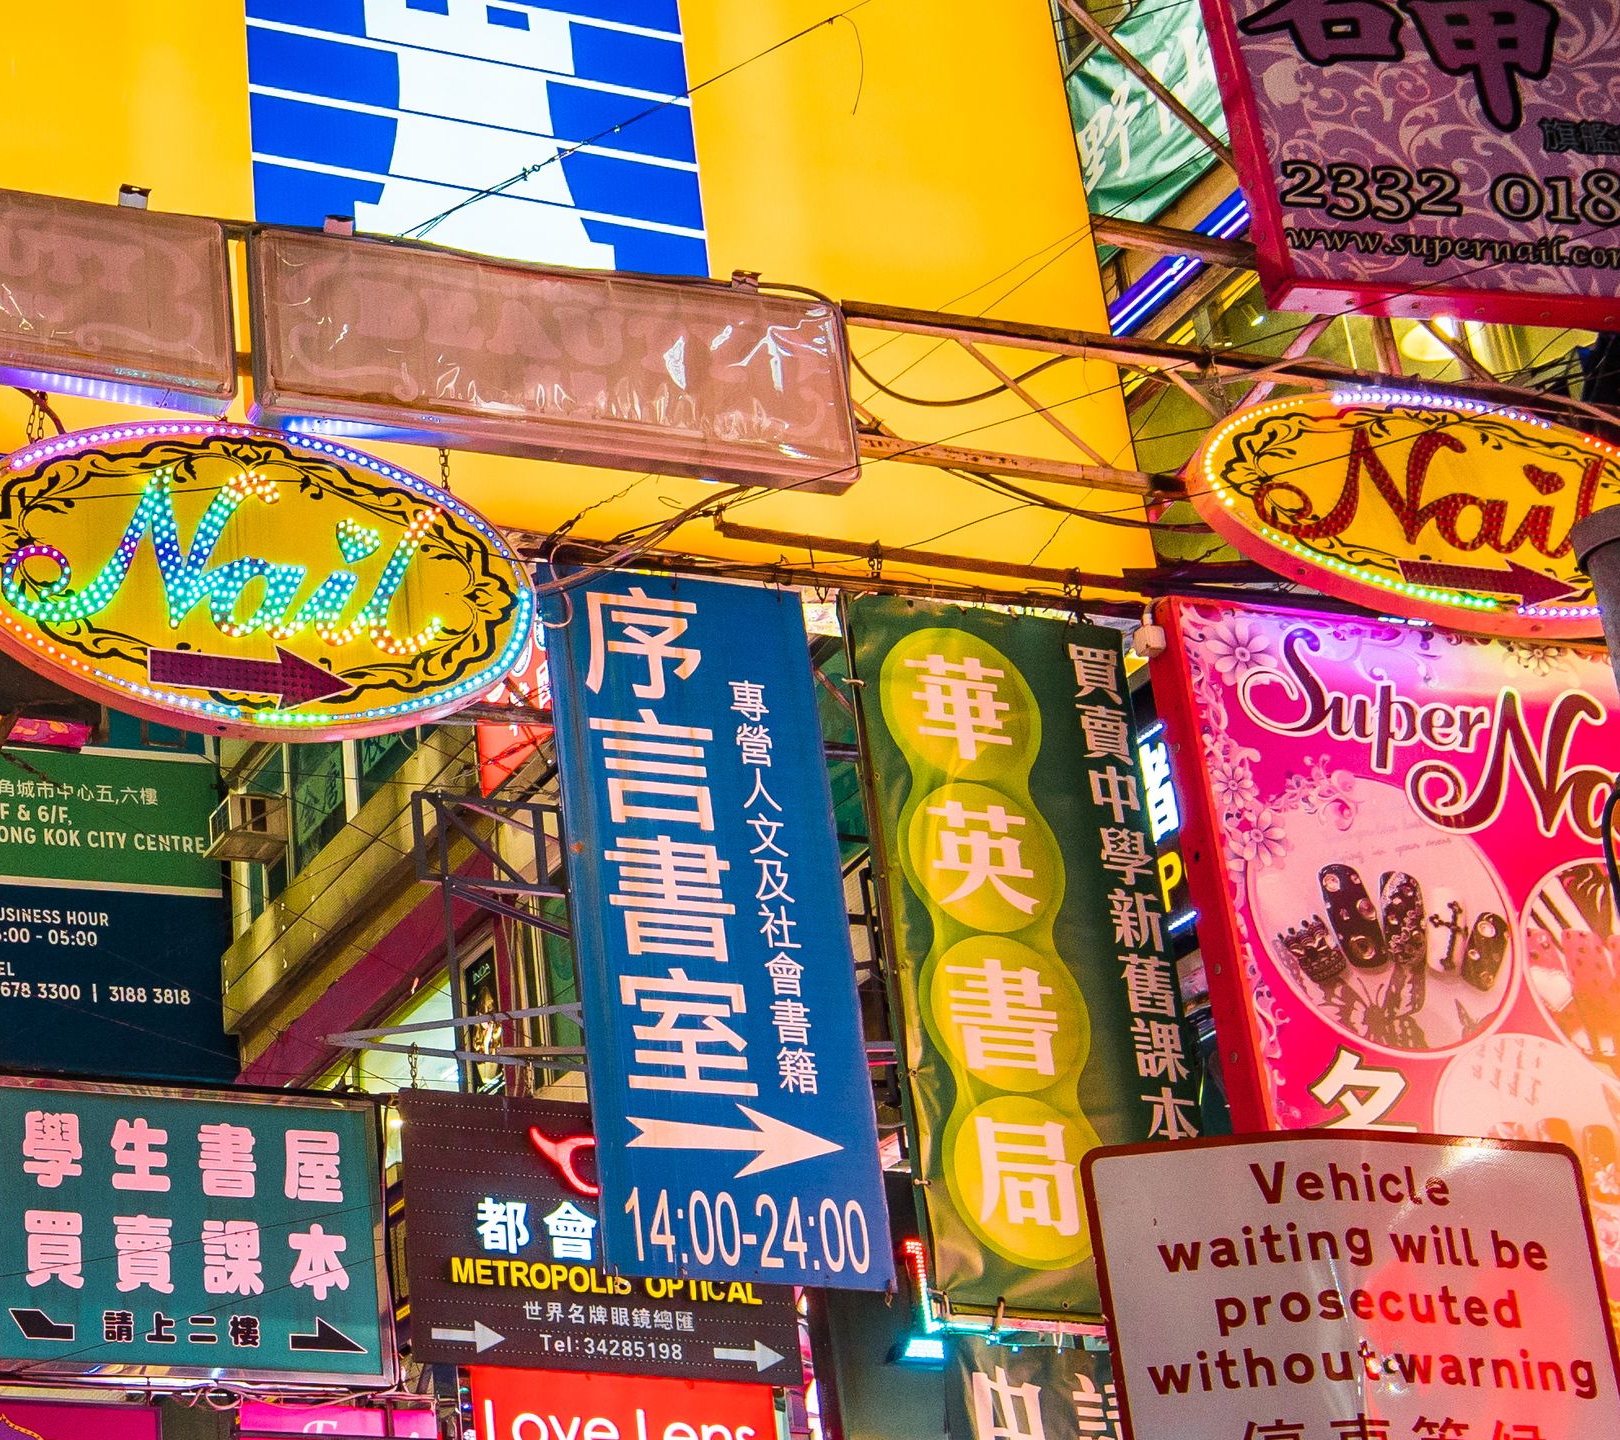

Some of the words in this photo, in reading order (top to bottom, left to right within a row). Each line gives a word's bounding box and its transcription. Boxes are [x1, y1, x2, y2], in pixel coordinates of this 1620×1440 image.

[1281, 160, 1464, 224] 2332
[1, 466, 444, 654] Nail
[43, 827, 81, 848] KOK
[87, 830, 127, 851] CITY
[132, 833, 206, 856] CENTRE
[584, 586, 759, 1098] 序言書室
[727, 679, 820, 1096] 專營人文及社會書籍
[49, 929, 98, 949] 05:00
[66, 910, 111, 929] HOUR
[904, 653, 1081, 1236] 華英書局
[37, 982, 82, 1002] 3300
[109, 986, 149, 1004] 3188
[153, 987, 192, 1006] 3818
[23, 1111, 344, 1204] 學生書屋
[1249, 1161, 1450, 1209] Vehicle
[24, 1208, 350, 1301] 買賣課本
[624, 1185, 872, 1274] 14:00-24:00
[1159, 1216, 1372, 1278] waiting
[1395, 1221, 1478, 1268] will
[1490, 1226, 1549, 1272] be
[102, 1310, 261, 1348] 請上二樓
[1214, 1279, 1522, 1341] prosecuted
[539, 1333, 684, 1360] Tel:34285198
[1148, 1341, 1382, 1399] without
[1392, 1350, 1599, 1403] warning
